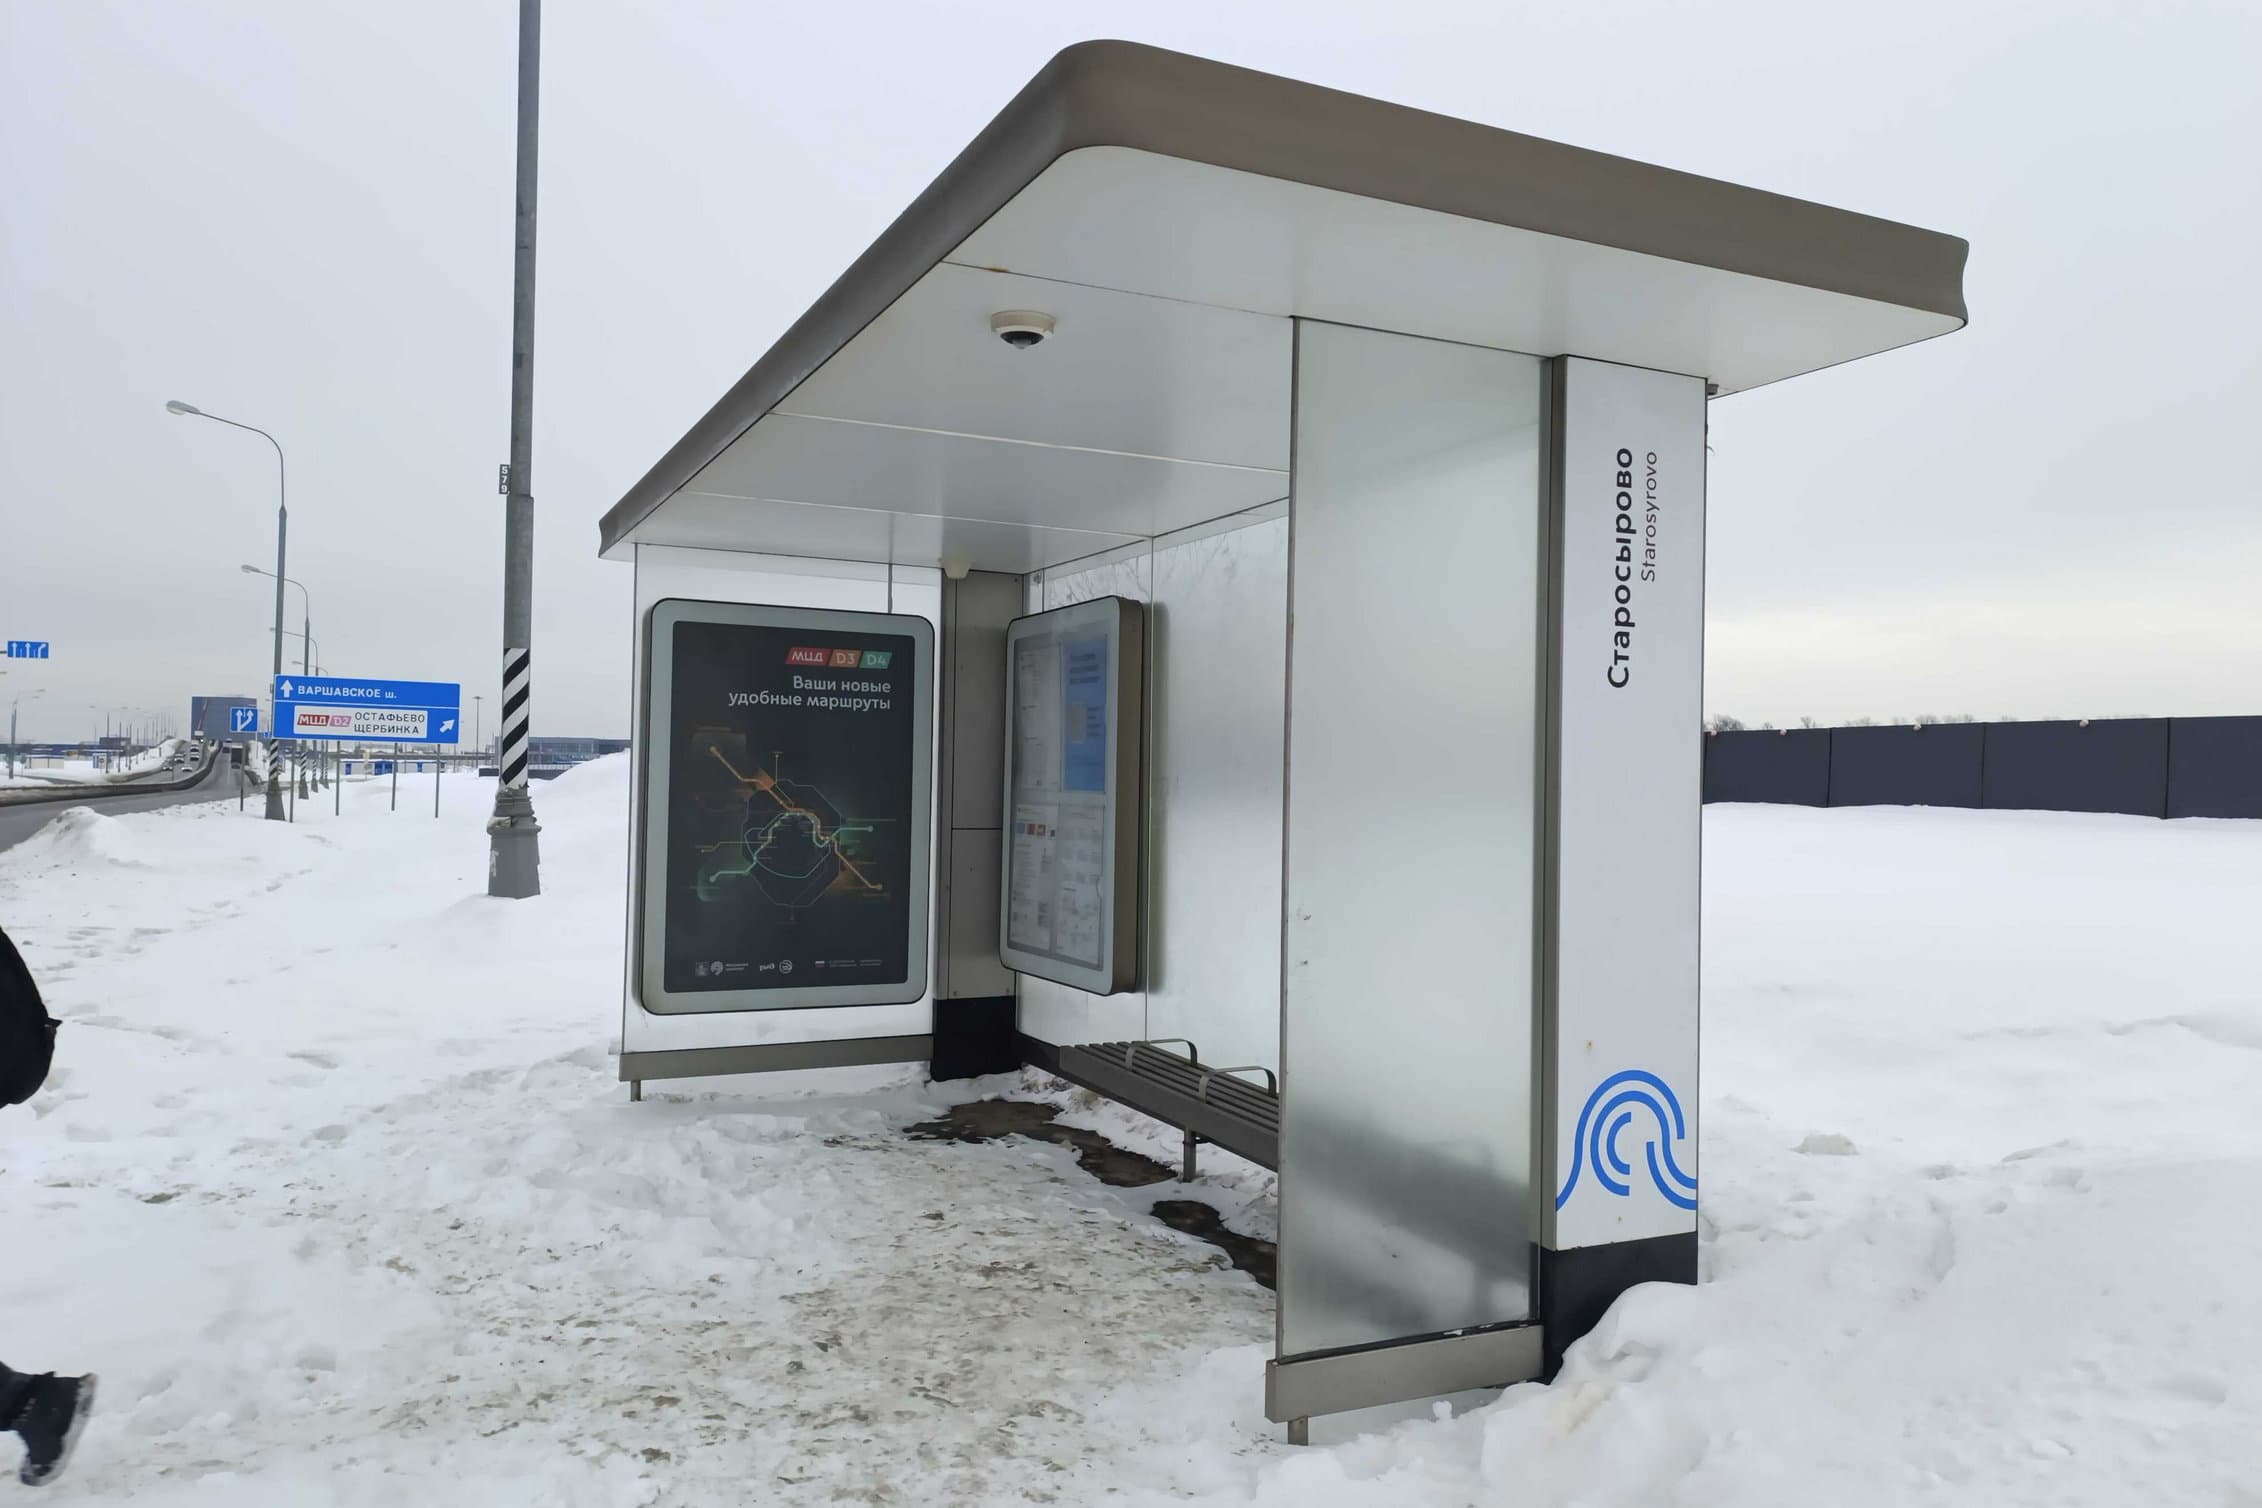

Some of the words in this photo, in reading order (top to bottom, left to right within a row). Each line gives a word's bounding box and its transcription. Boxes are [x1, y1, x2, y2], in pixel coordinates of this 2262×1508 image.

[1641, 451, 1660, 582] Starosyrovo
[1607, 448, 1637, 688] Старосырово
[791, 651, 824, 662] МЦД
[836, 652, 856, 665] D3
[867, 654, 886, 666] D4
[298, 685, 381, 698] ВАРШАВСКОЕ
[793, 675, 836, 691] Ваши
[841, 680, 891, 693] новые
[728, 690, 802, 707] удобные
[807, 694, 890, 712] маршруты
[299, 715, 327, 726] МЦД
[354, 711, 425, 723] ОСТАФЬЕВО
[354, 724, 419, 734] ЩЕРБИНКА
